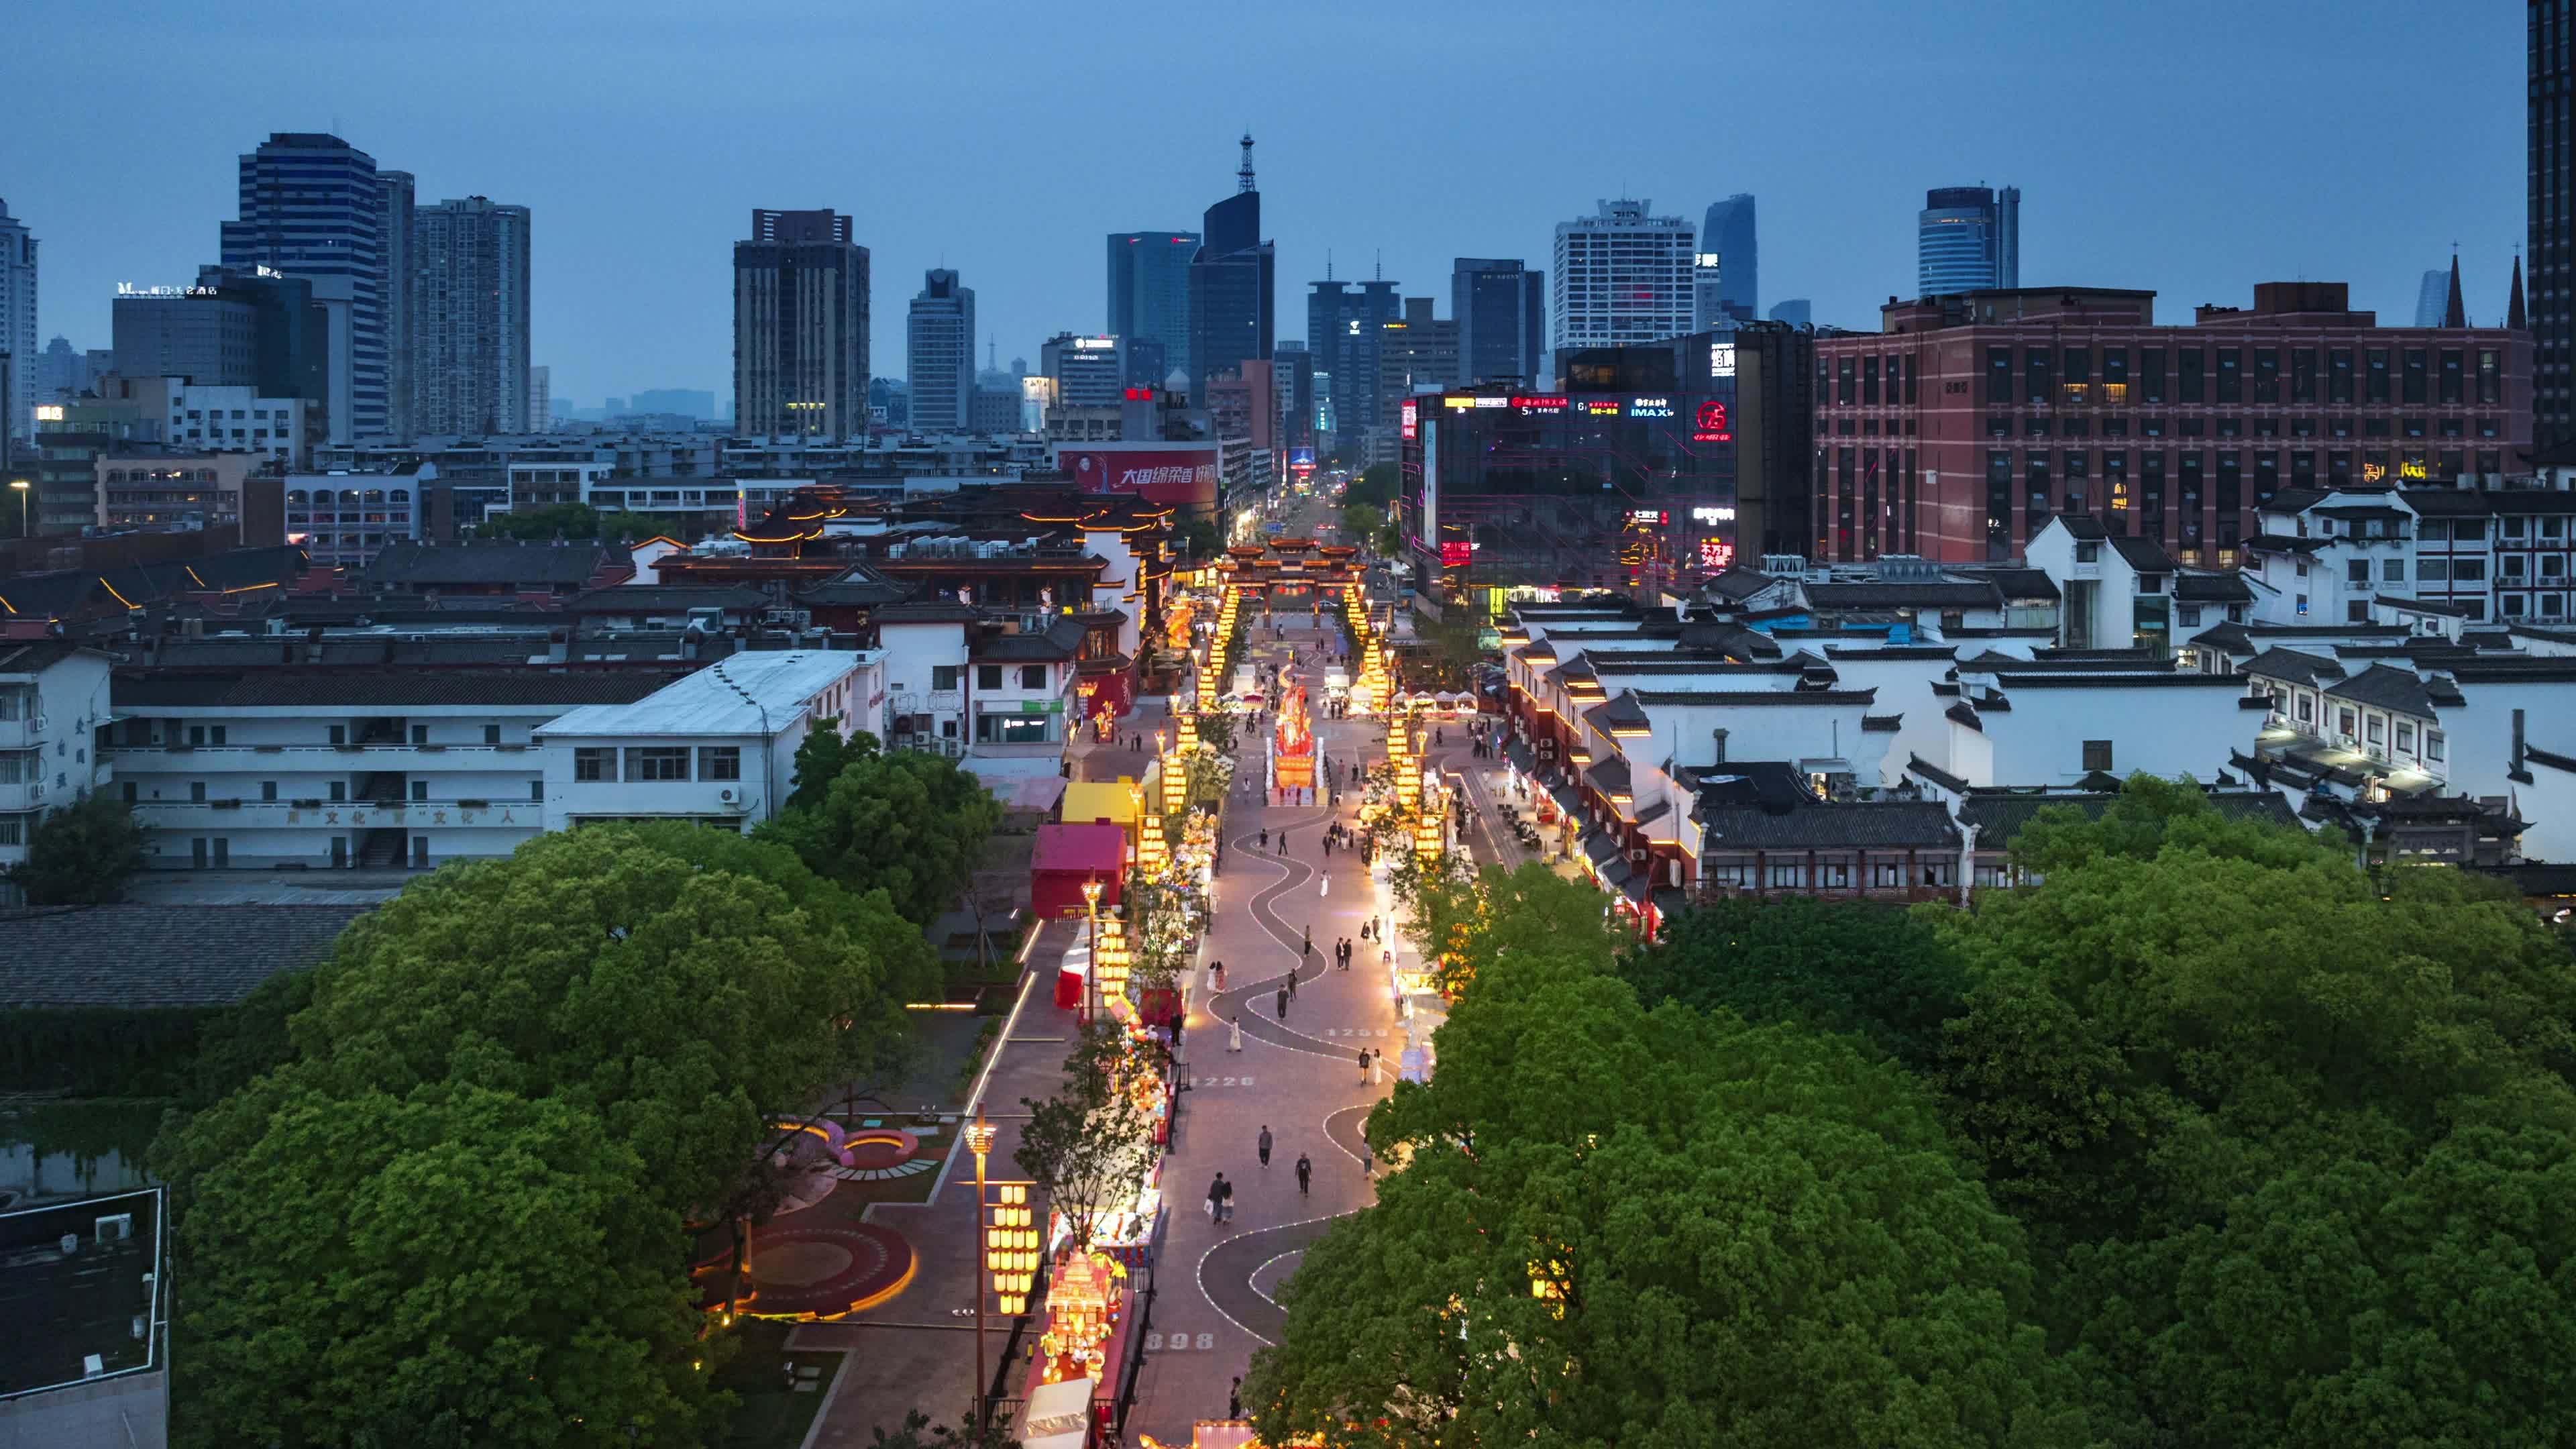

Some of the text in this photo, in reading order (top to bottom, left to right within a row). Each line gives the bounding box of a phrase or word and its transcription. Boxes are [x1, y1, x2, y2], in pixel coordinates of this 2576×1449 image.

[1631, 409, 1667, 417] IMAX
[1121, 466, 1193, 484] 大国绵柔香
